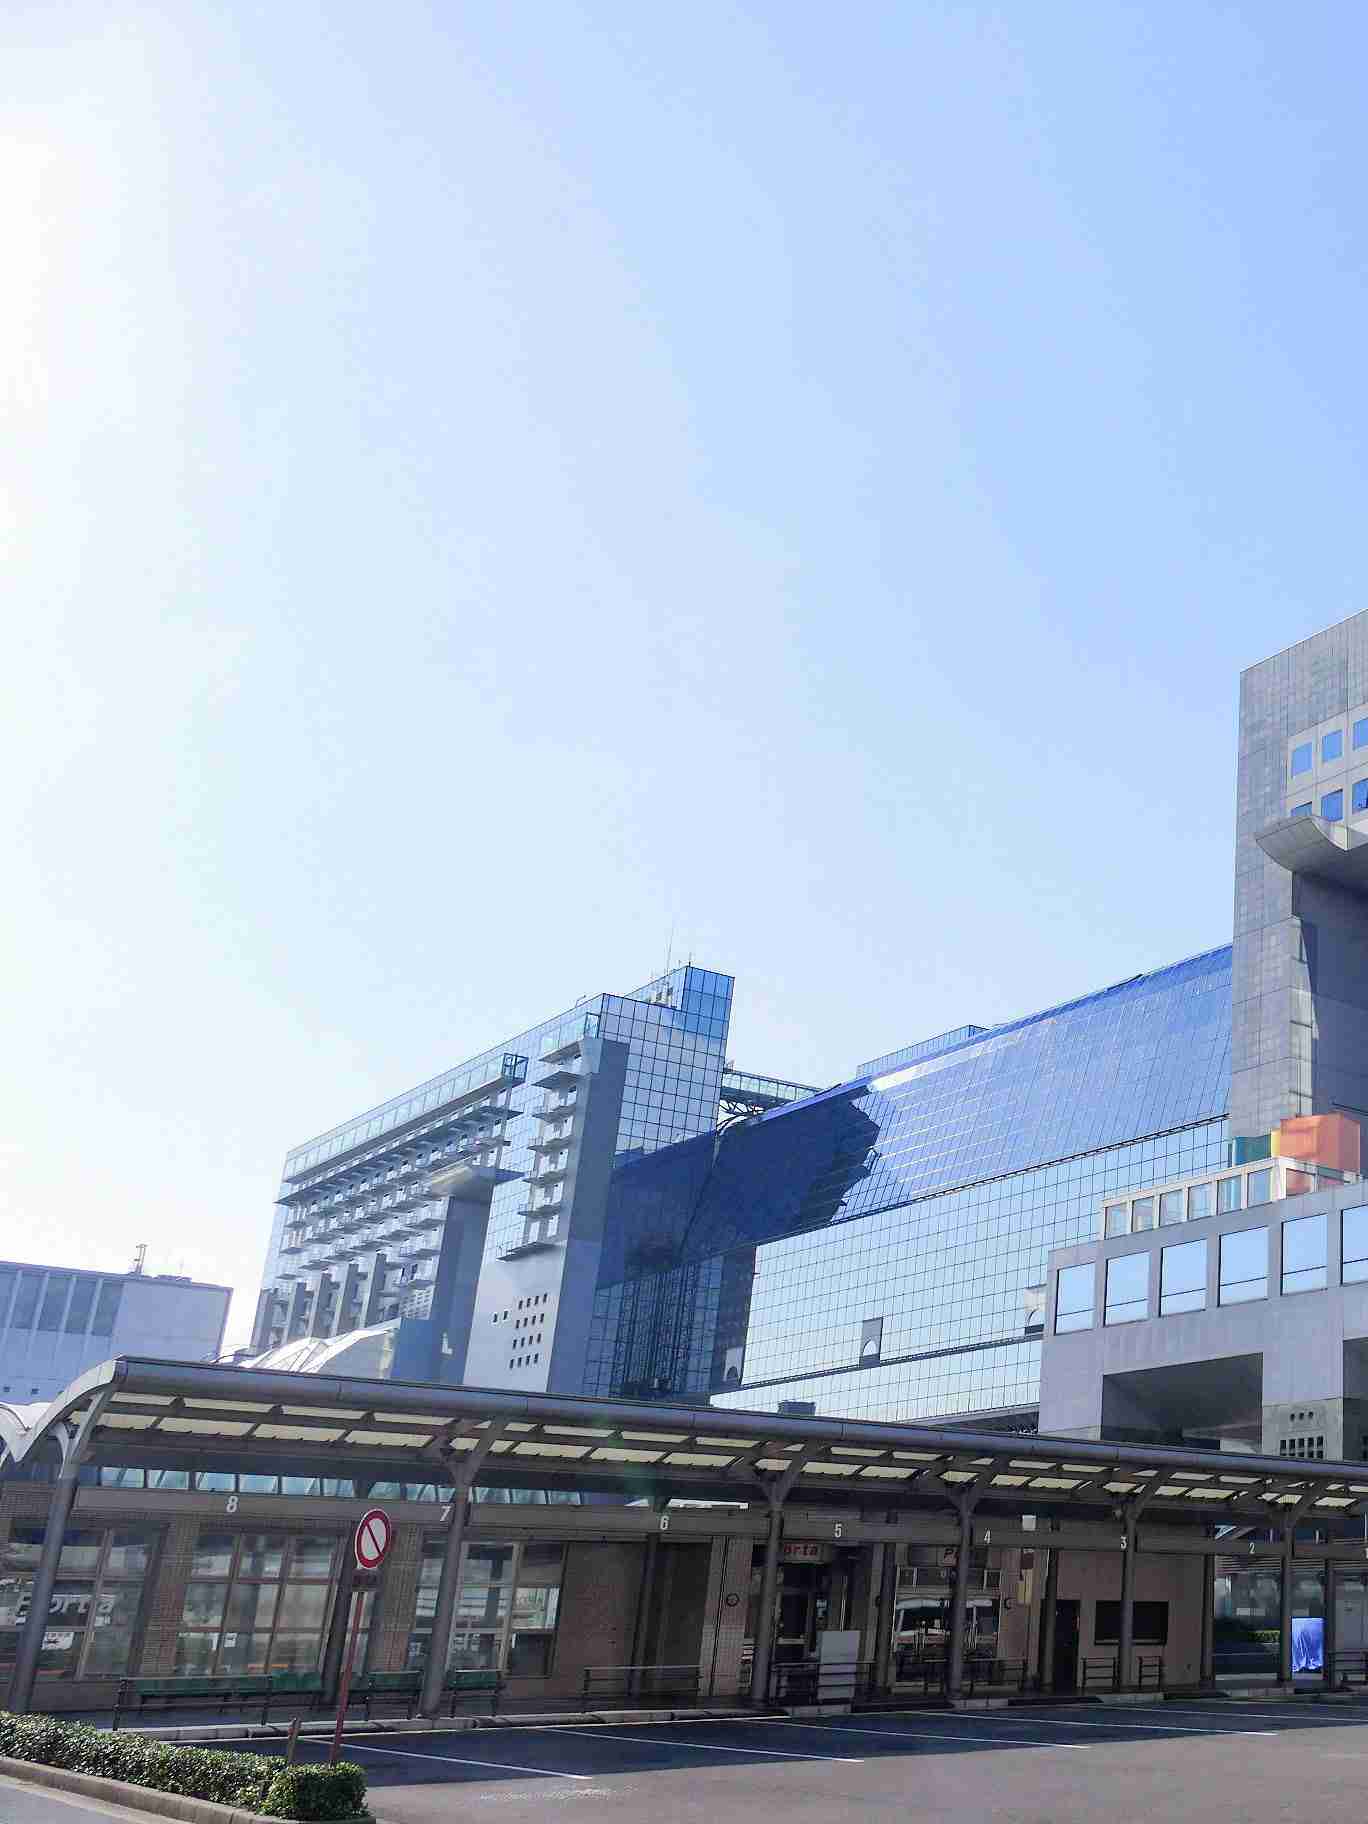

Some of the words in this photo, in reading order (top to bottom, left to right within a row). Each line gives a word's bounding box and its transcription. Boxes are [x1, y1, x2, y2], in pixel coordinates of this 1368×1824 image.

[225, 1495, 238, 1513] 8
[439, 1505, 452, 1522] 7
[659, 1515, 669, 1530] 6
[834, 1523, 842, 1538] 5
[983, 1529, 991, 1544] 4
[1120, 1535, 1128, 1549] 3
[1249, 1541, 1256, 1554] 2
